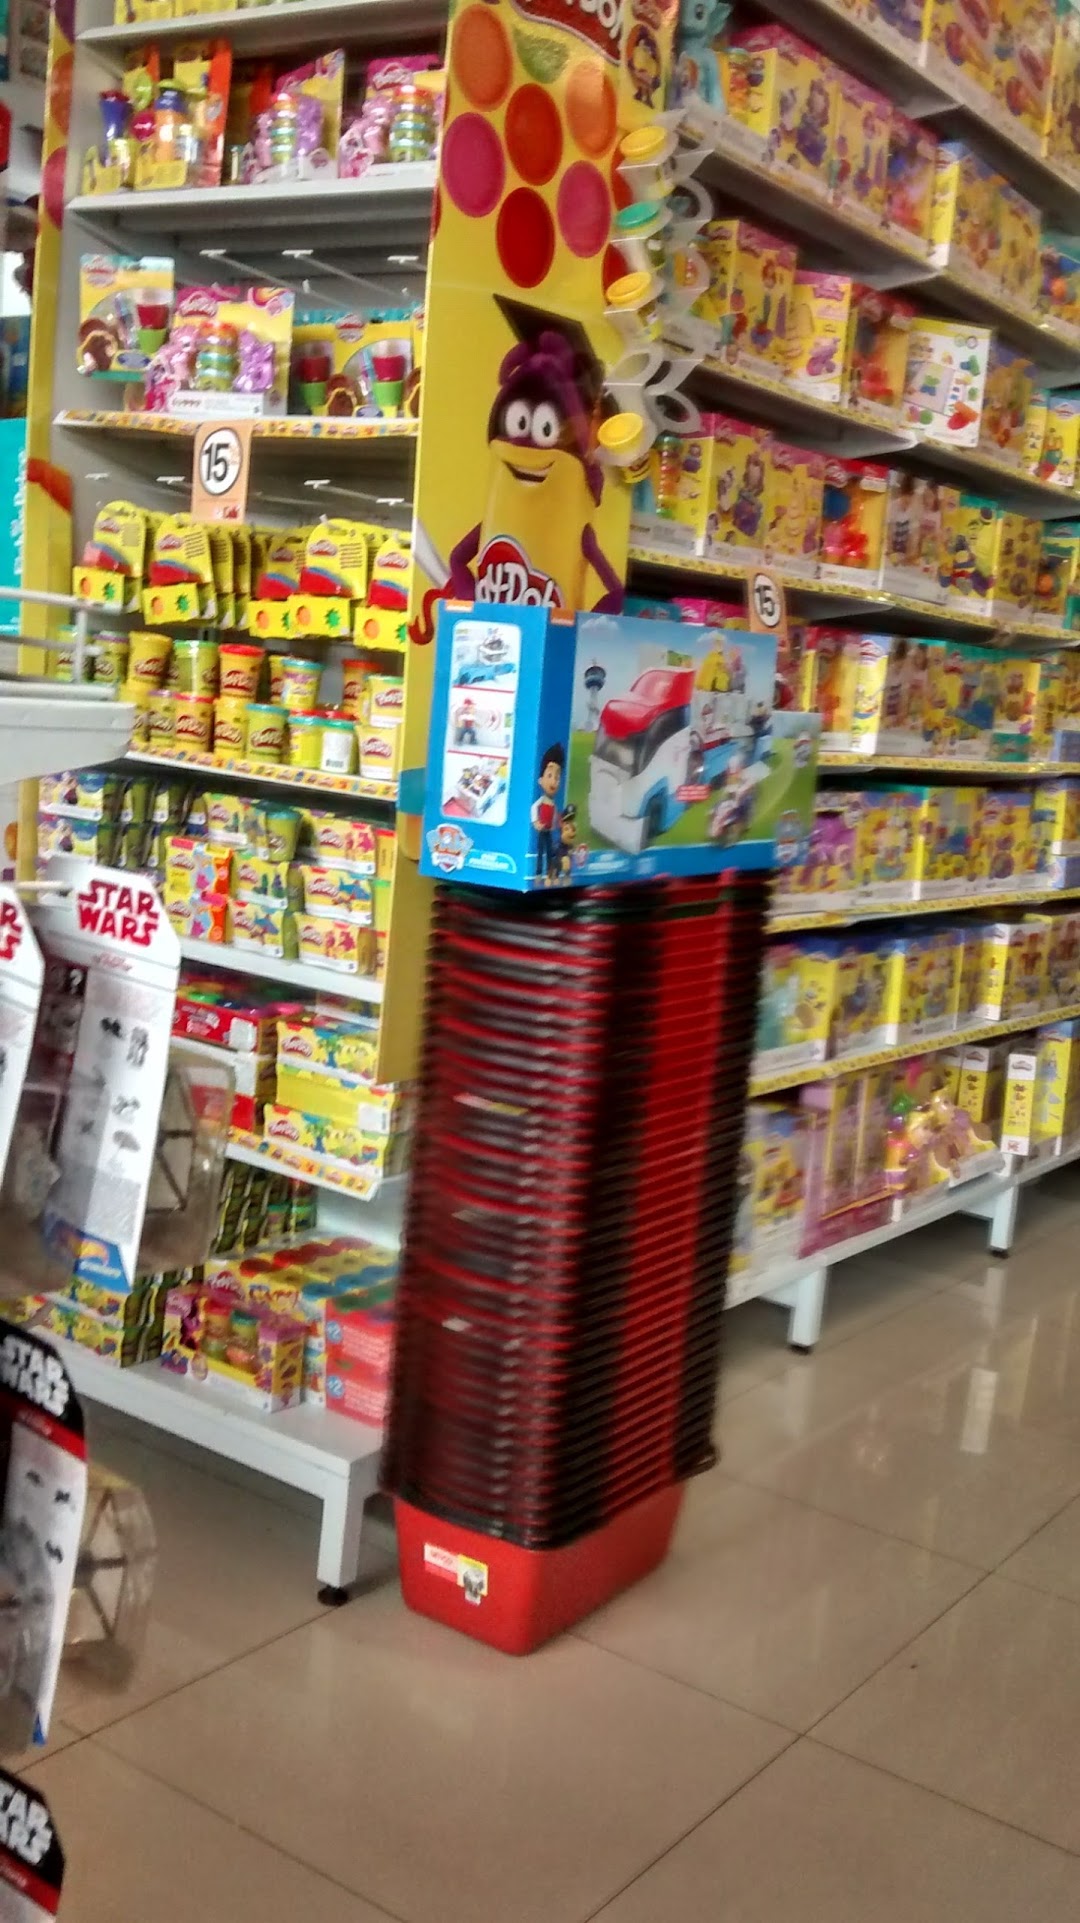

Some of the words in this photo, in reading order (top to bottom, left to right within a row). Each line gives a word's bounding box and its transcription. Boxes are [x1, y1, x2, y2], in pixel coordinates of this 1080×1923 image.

[204, 442, 230, 483] 15
[755, 585, 775, 617] 15
[78, 879, 159, 919] STAR
[78, 904, 158, 947] WARS
